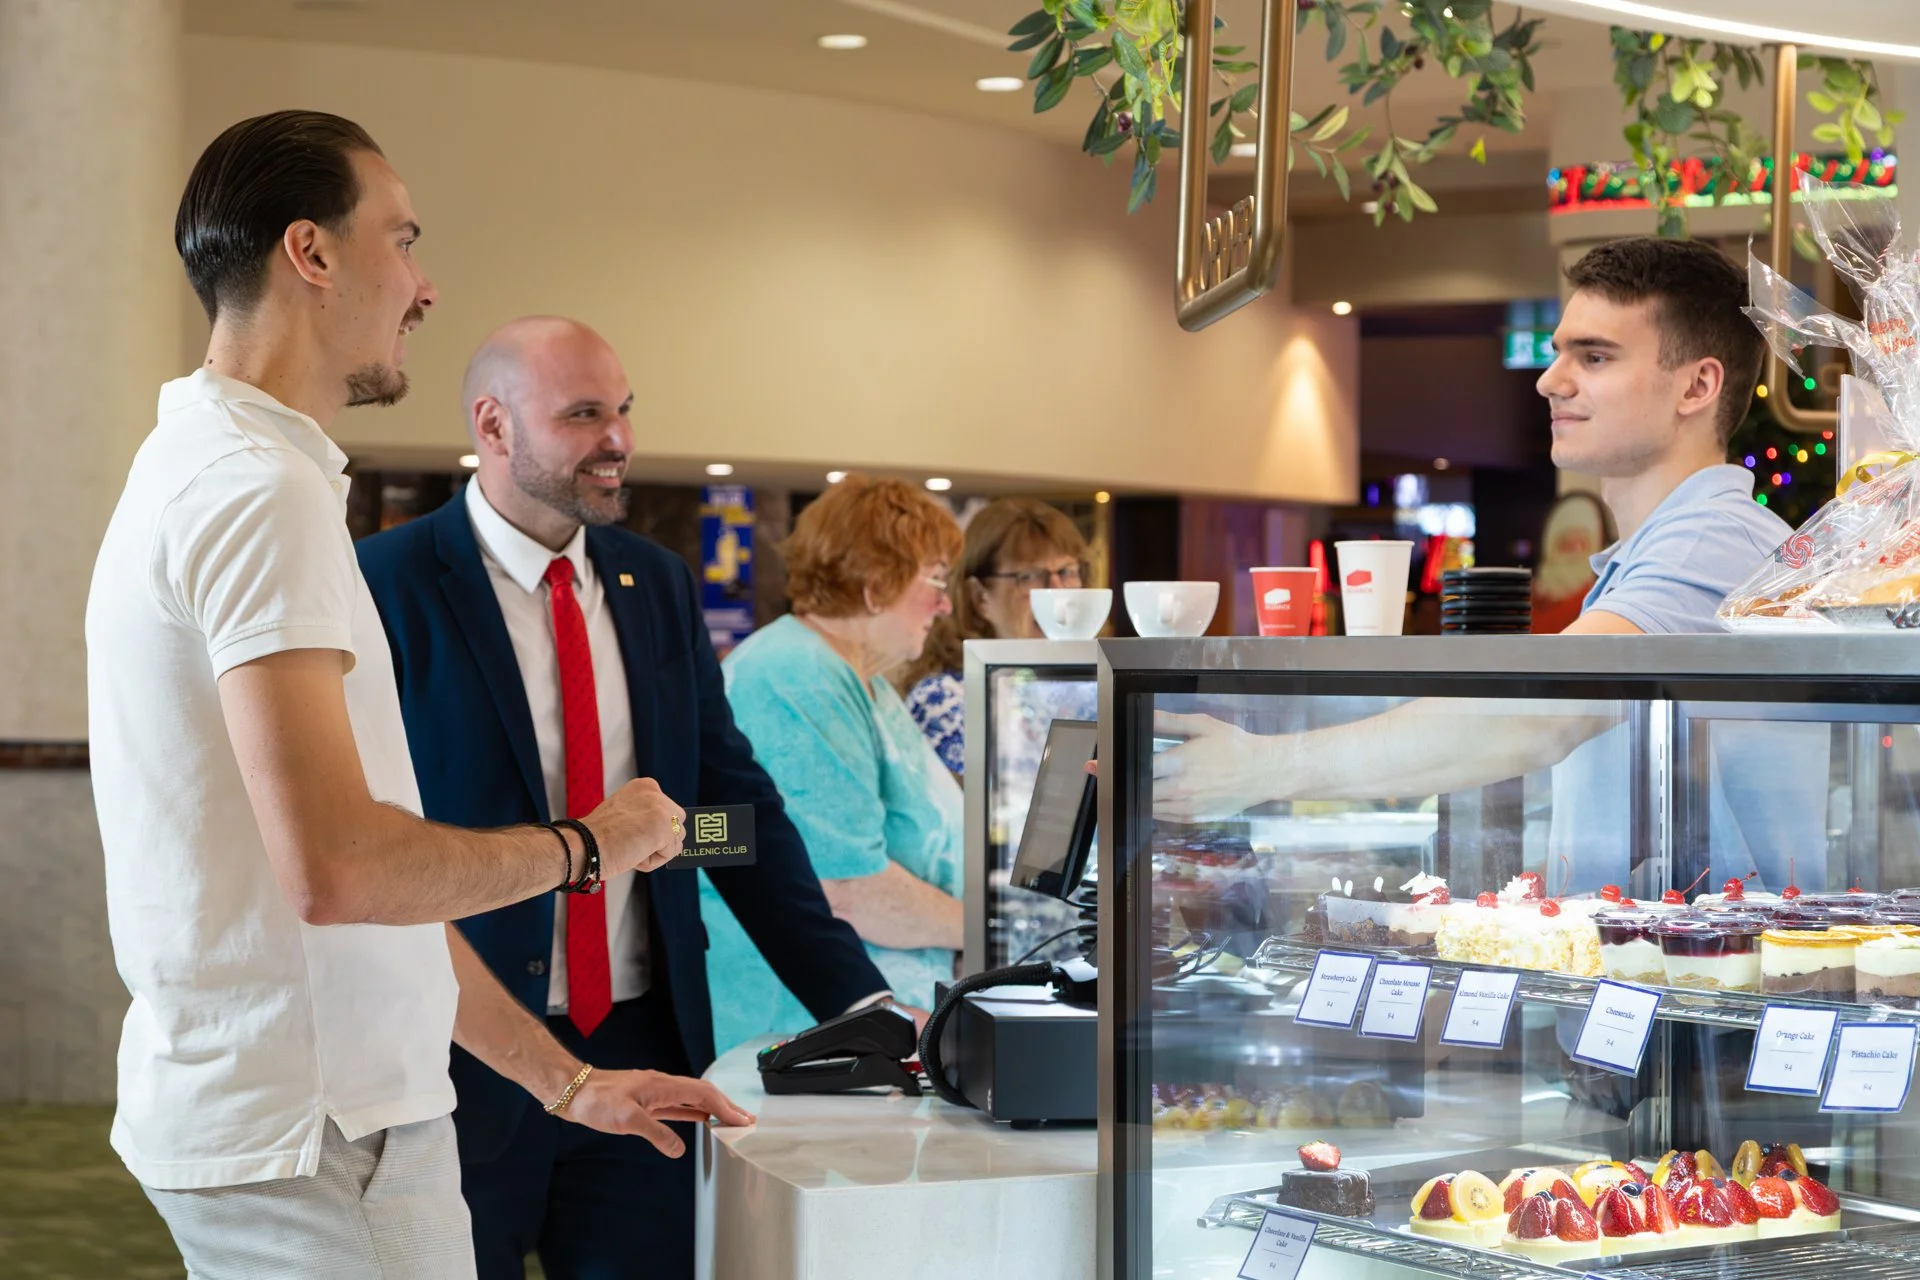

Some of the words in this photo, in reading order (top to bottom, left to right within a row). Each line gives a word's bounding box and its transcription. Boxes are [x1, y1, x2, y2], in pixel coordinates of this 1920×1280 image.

[722, 845, 747, 855] CLUB
[1320, 973, 1346, 984] Strawberry
[1345, 975, 1358, 983] Cake
[1379, 978, 1402, 987] Chocolate
[1402, 979, 1421, 988] Mousse
[1391, 989, 1403, 997] Cake
[1458, 989, 1478, 998] Almond
[1478, 991, 1496, 999] Vanilla
[1496, 992, 1510, 1001] Cake
[1606, 1006, 1636, 1020] Cheesecake
[1776, 1030, 1799, 1042] Orange
[1800, 1031, 1815, 1040] Cake
[1851, 1049, 1881, 1059] Pistachio
[1881, 1050, 1899, 1059] Cake
[1265, 1227, 1286, 1237] Chocolate
[1291, 1233, 1306, 1242] Vanilla
